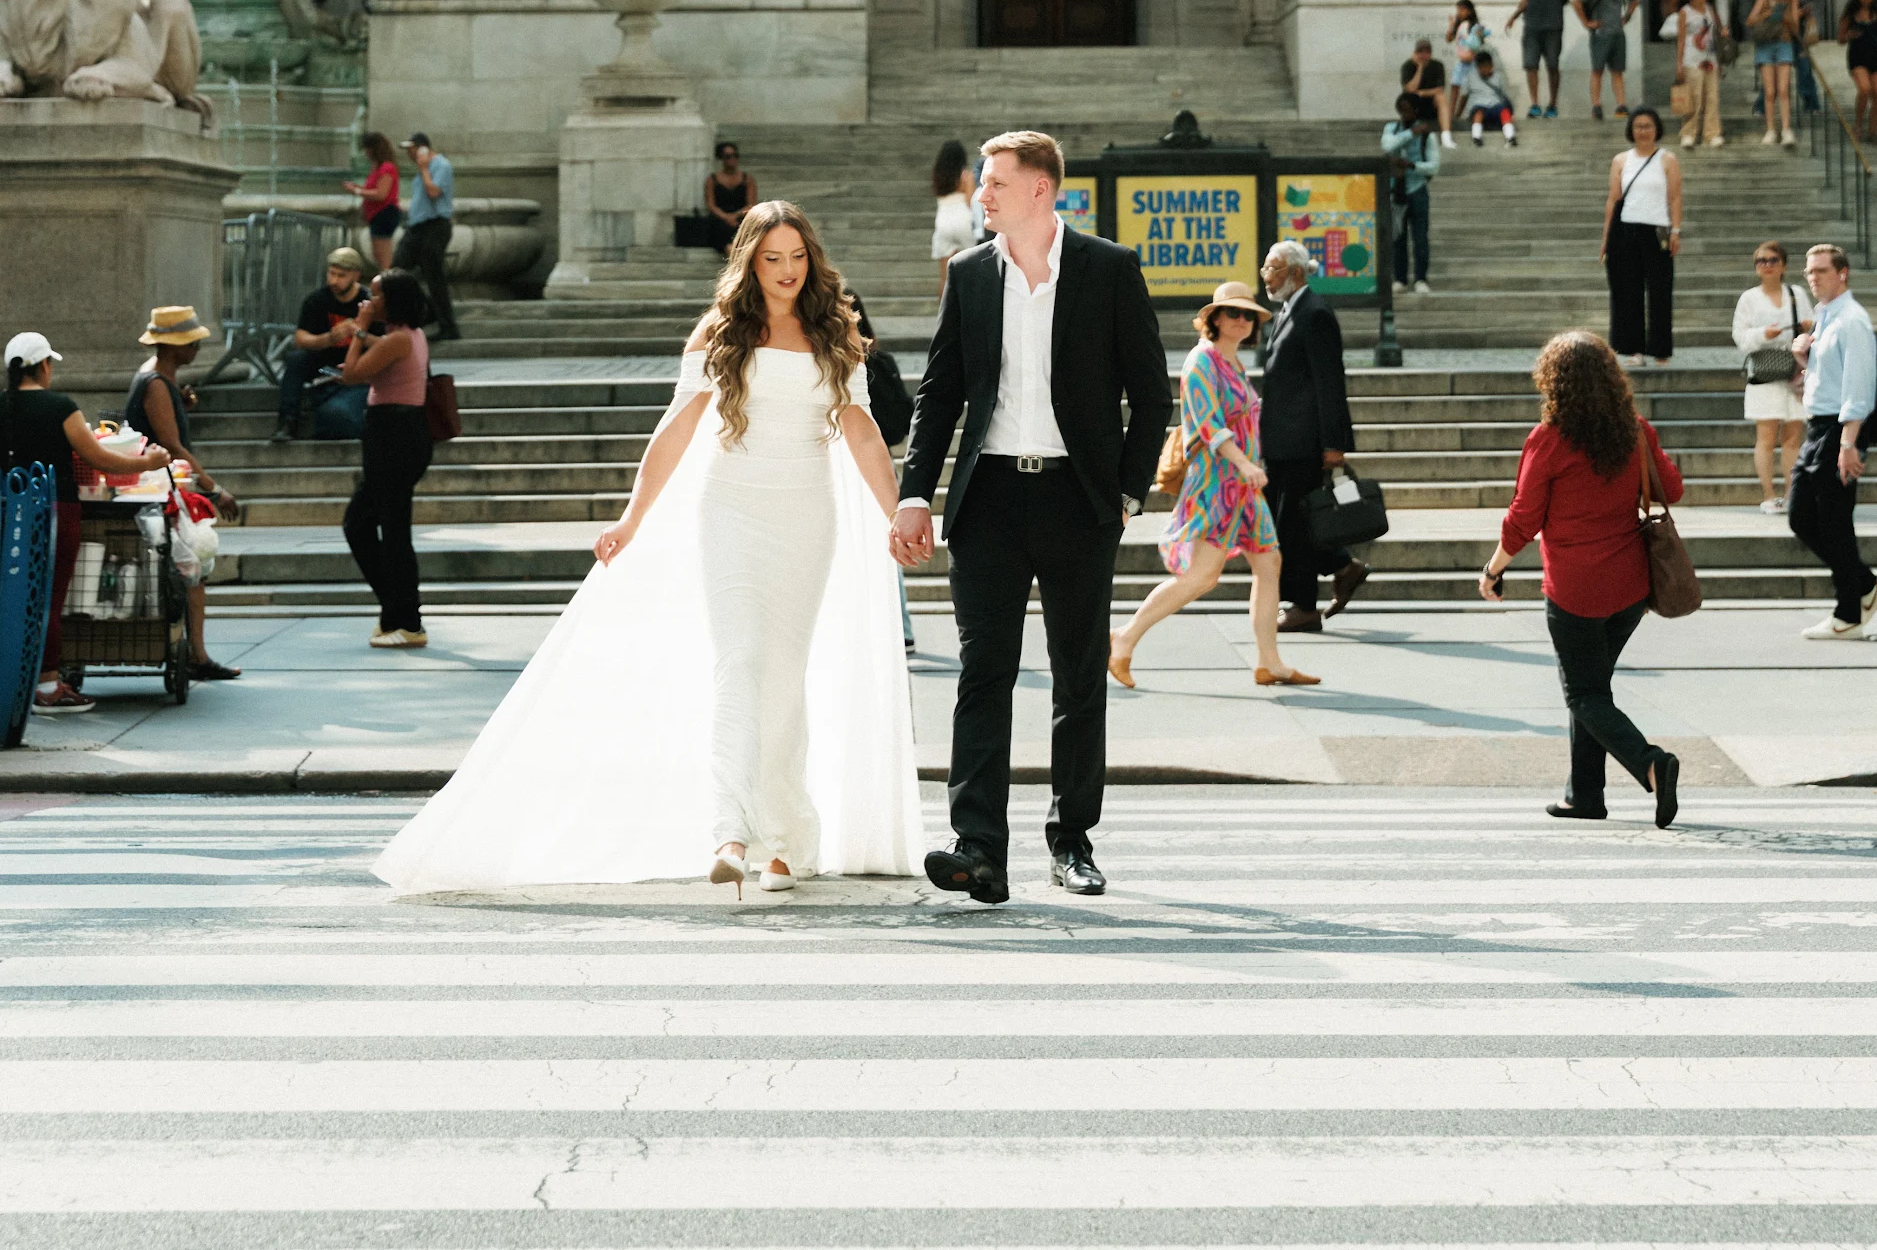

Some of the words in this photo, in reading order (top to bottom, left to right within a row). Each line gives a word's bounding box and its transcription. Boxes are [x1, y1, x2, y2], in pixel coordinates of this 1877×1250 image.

[1132, 190, 1241, 214] SUMMER
[1147, 216, 1175, 240] AT
[1182, 216, 1226, 240] THE
[1135, 242, 1239, 267] LIBRARY
